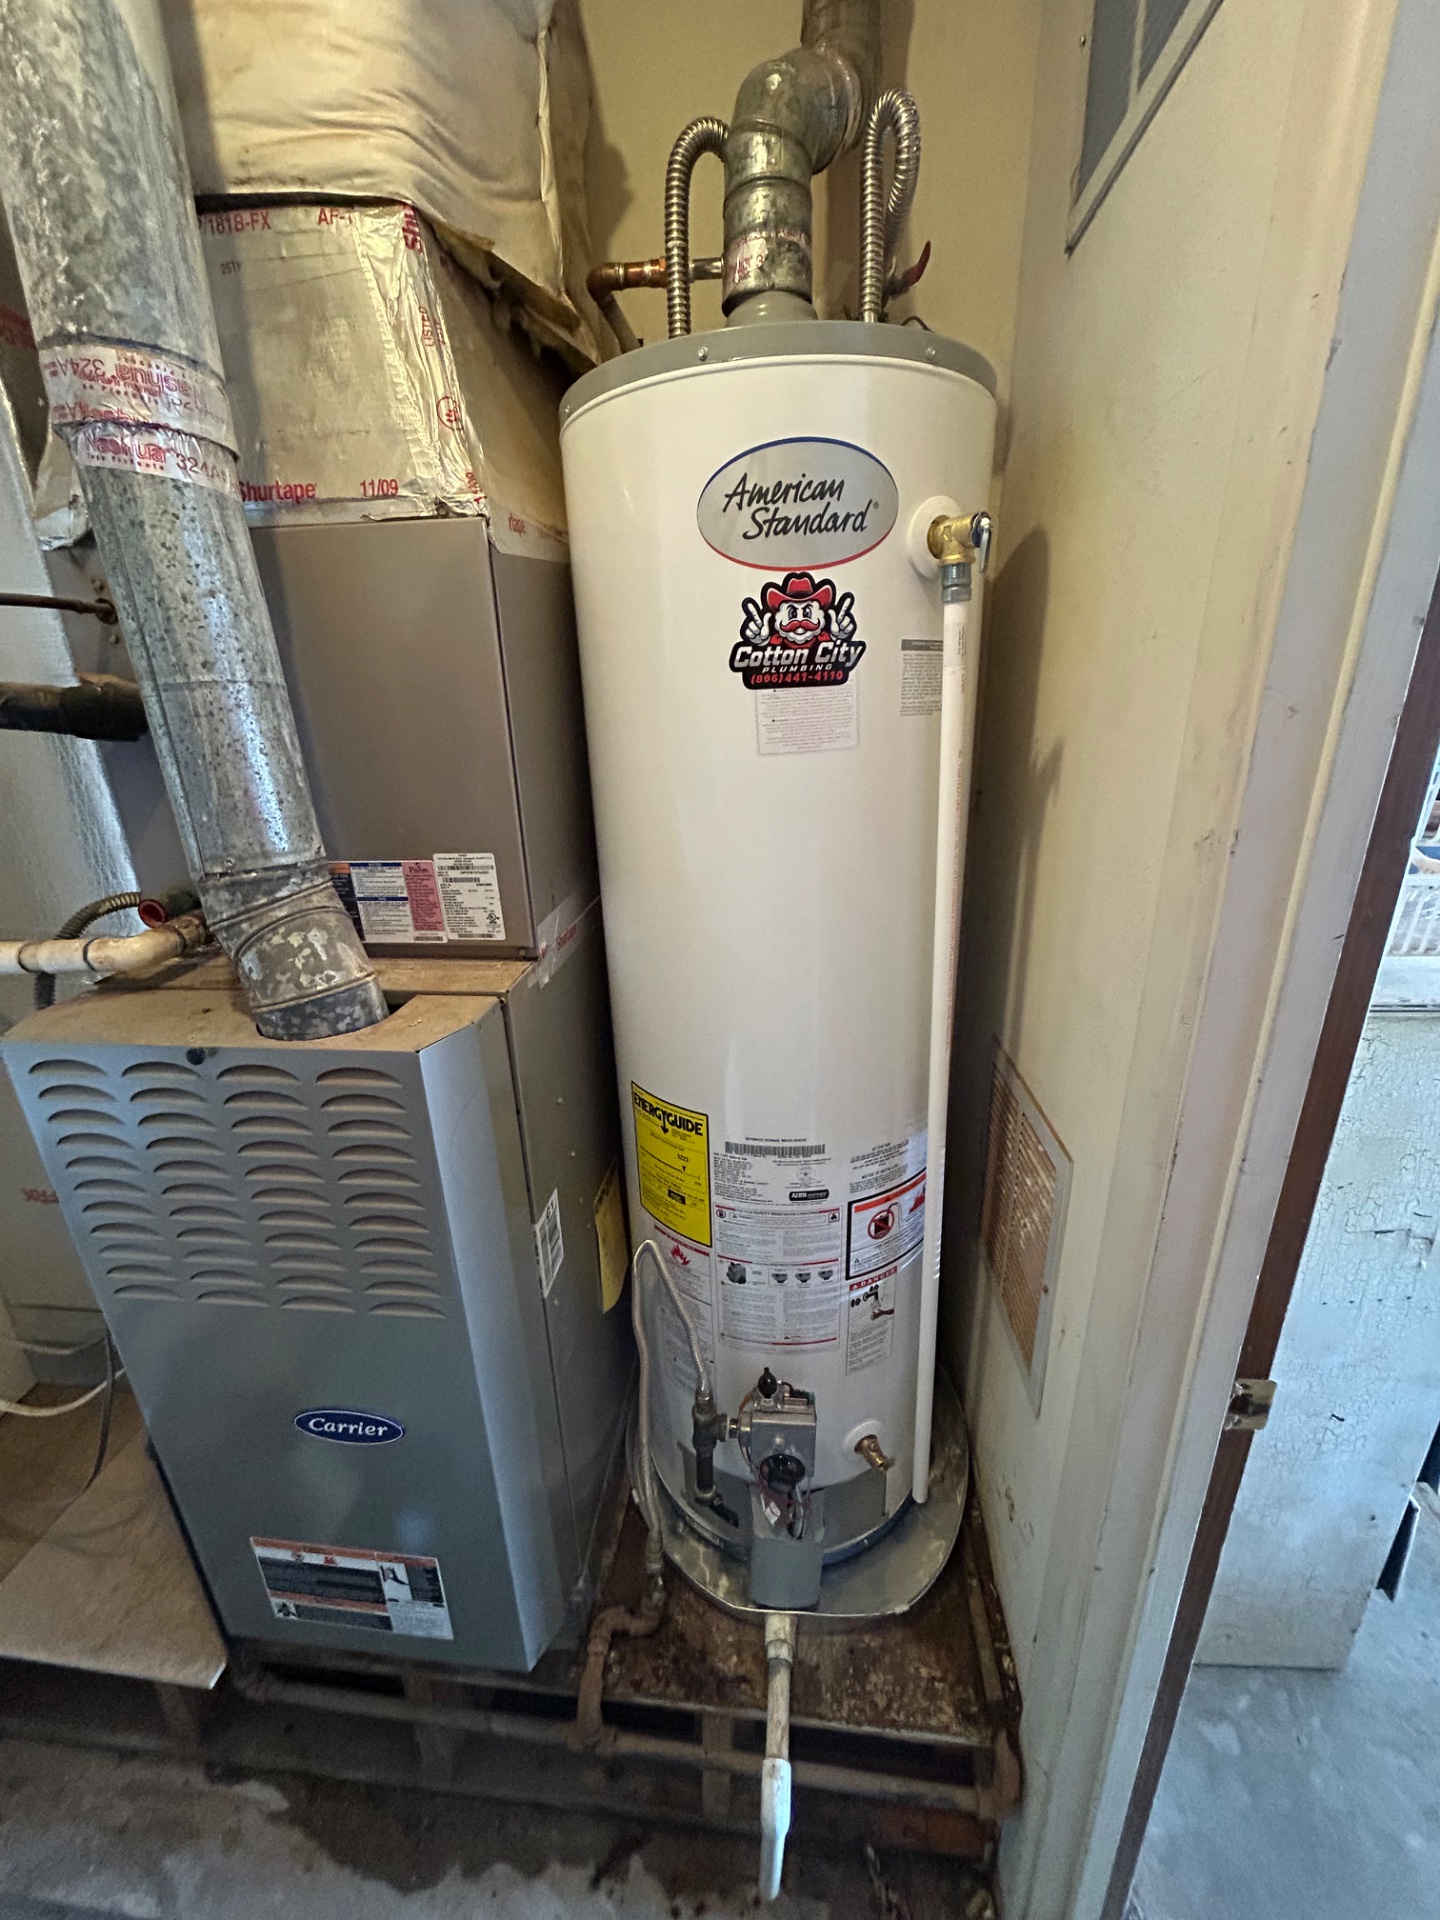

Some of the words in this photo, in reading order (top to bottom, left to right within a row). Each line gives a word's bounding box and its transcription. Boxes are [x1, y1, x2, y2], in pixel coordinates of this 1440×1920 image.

[359, 478, 399, 498] 11/09
[722, 472, 845, 513] American
[742, 499, 873, 540] Standard
[733, 644, 810, 668] Cotton
[814, 640, 864, 668] City
[750, 670, 844, 685] (806)441-4110
[762, 663, 833, 674] PLUMBING
[308, 1417, 389, 1437] Carrier
